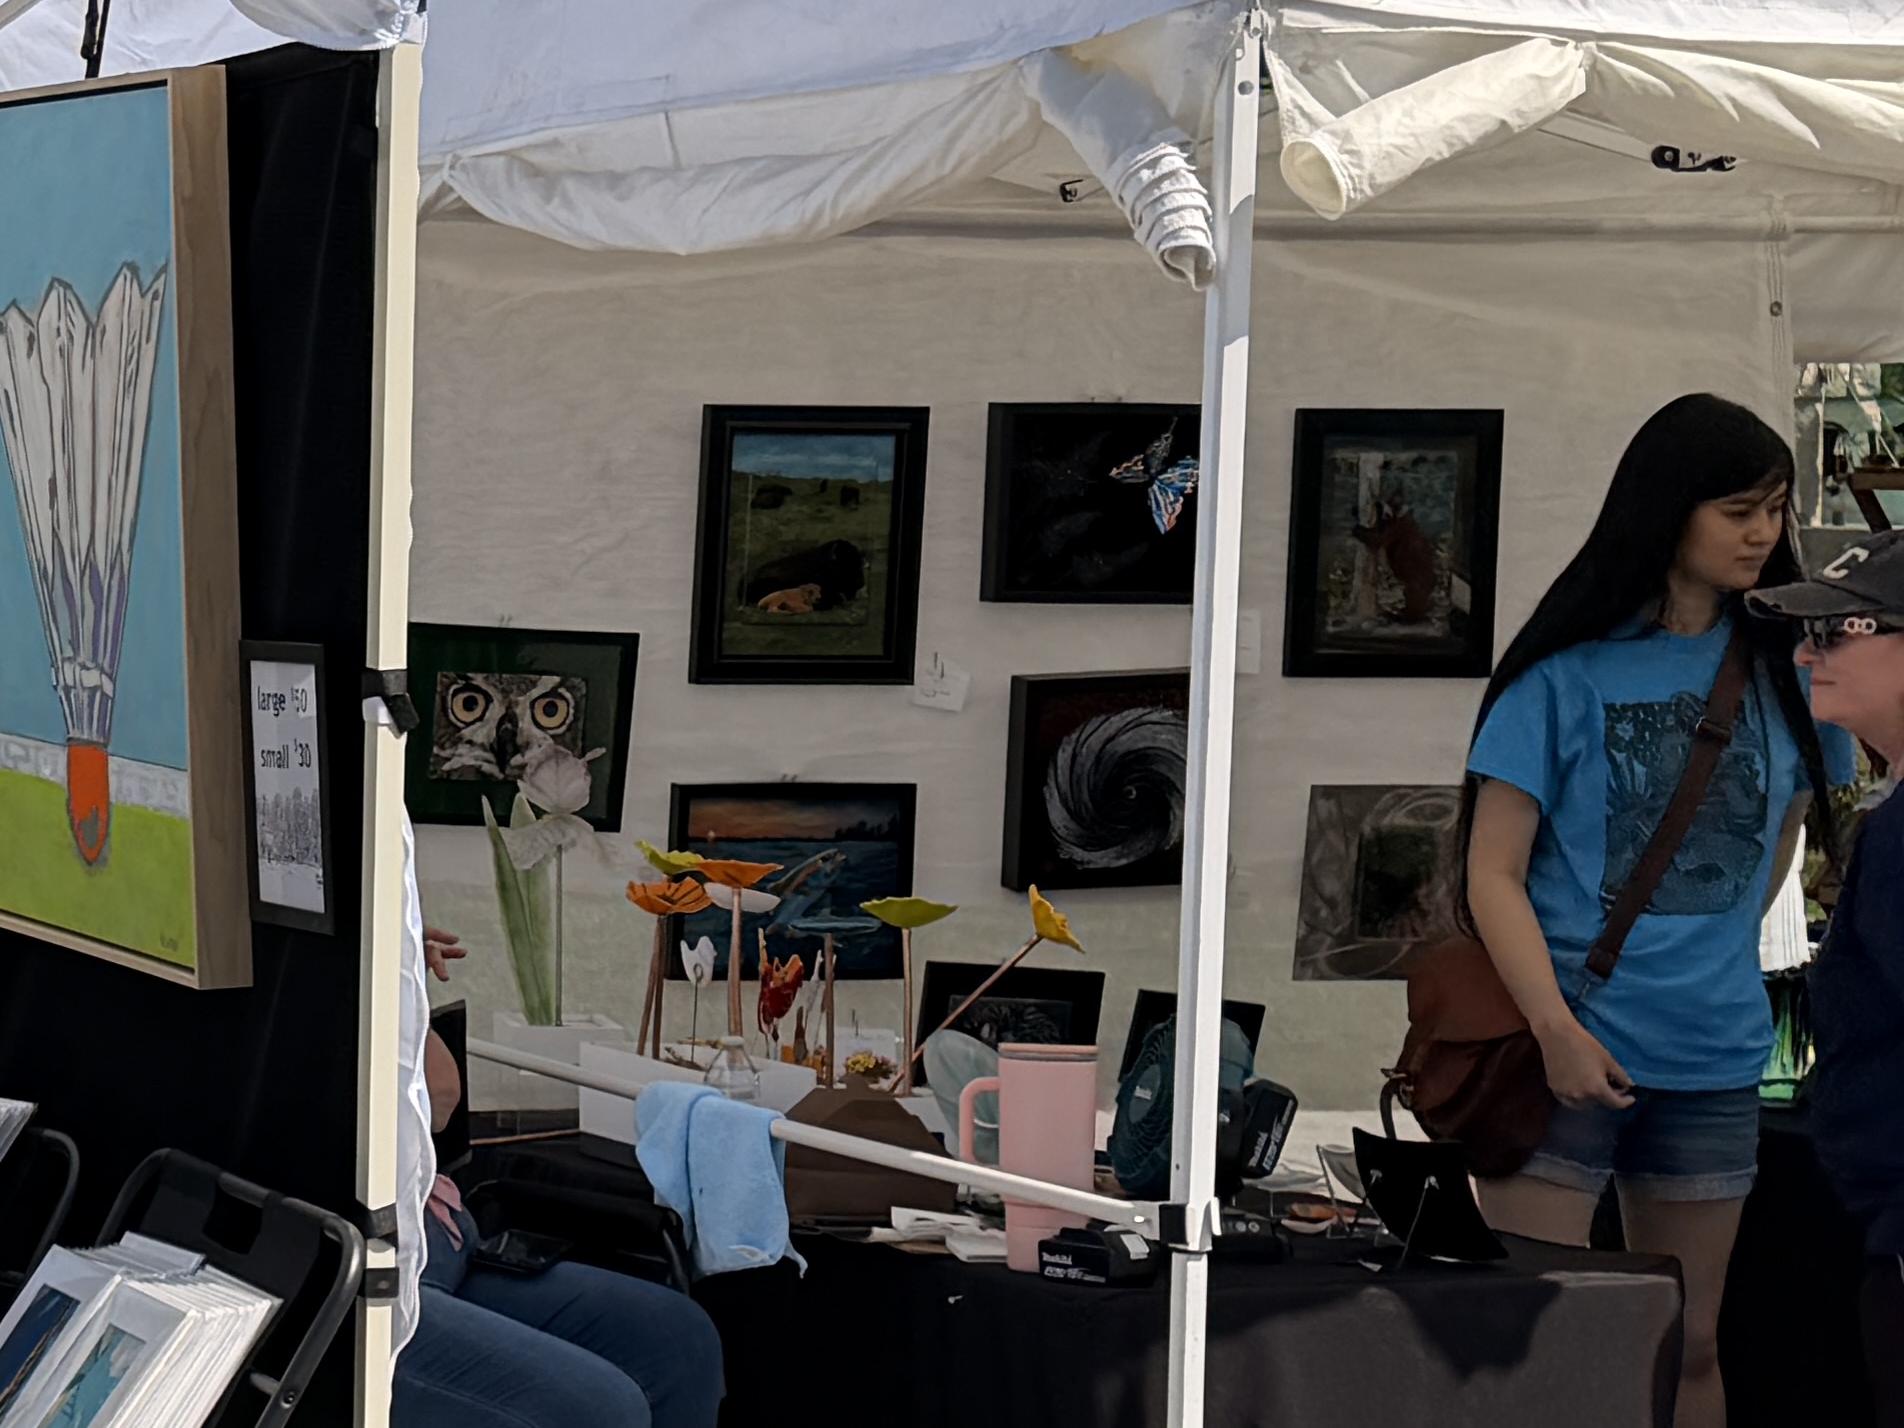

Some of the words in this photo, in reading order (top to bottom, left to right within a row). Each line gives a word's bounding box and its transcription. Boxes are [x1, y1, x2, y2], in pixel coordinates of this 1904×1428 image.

[1823, 546, 1870, 579] C
[257, 684, 287, 717] large
[261, 744, 290, 769] small
